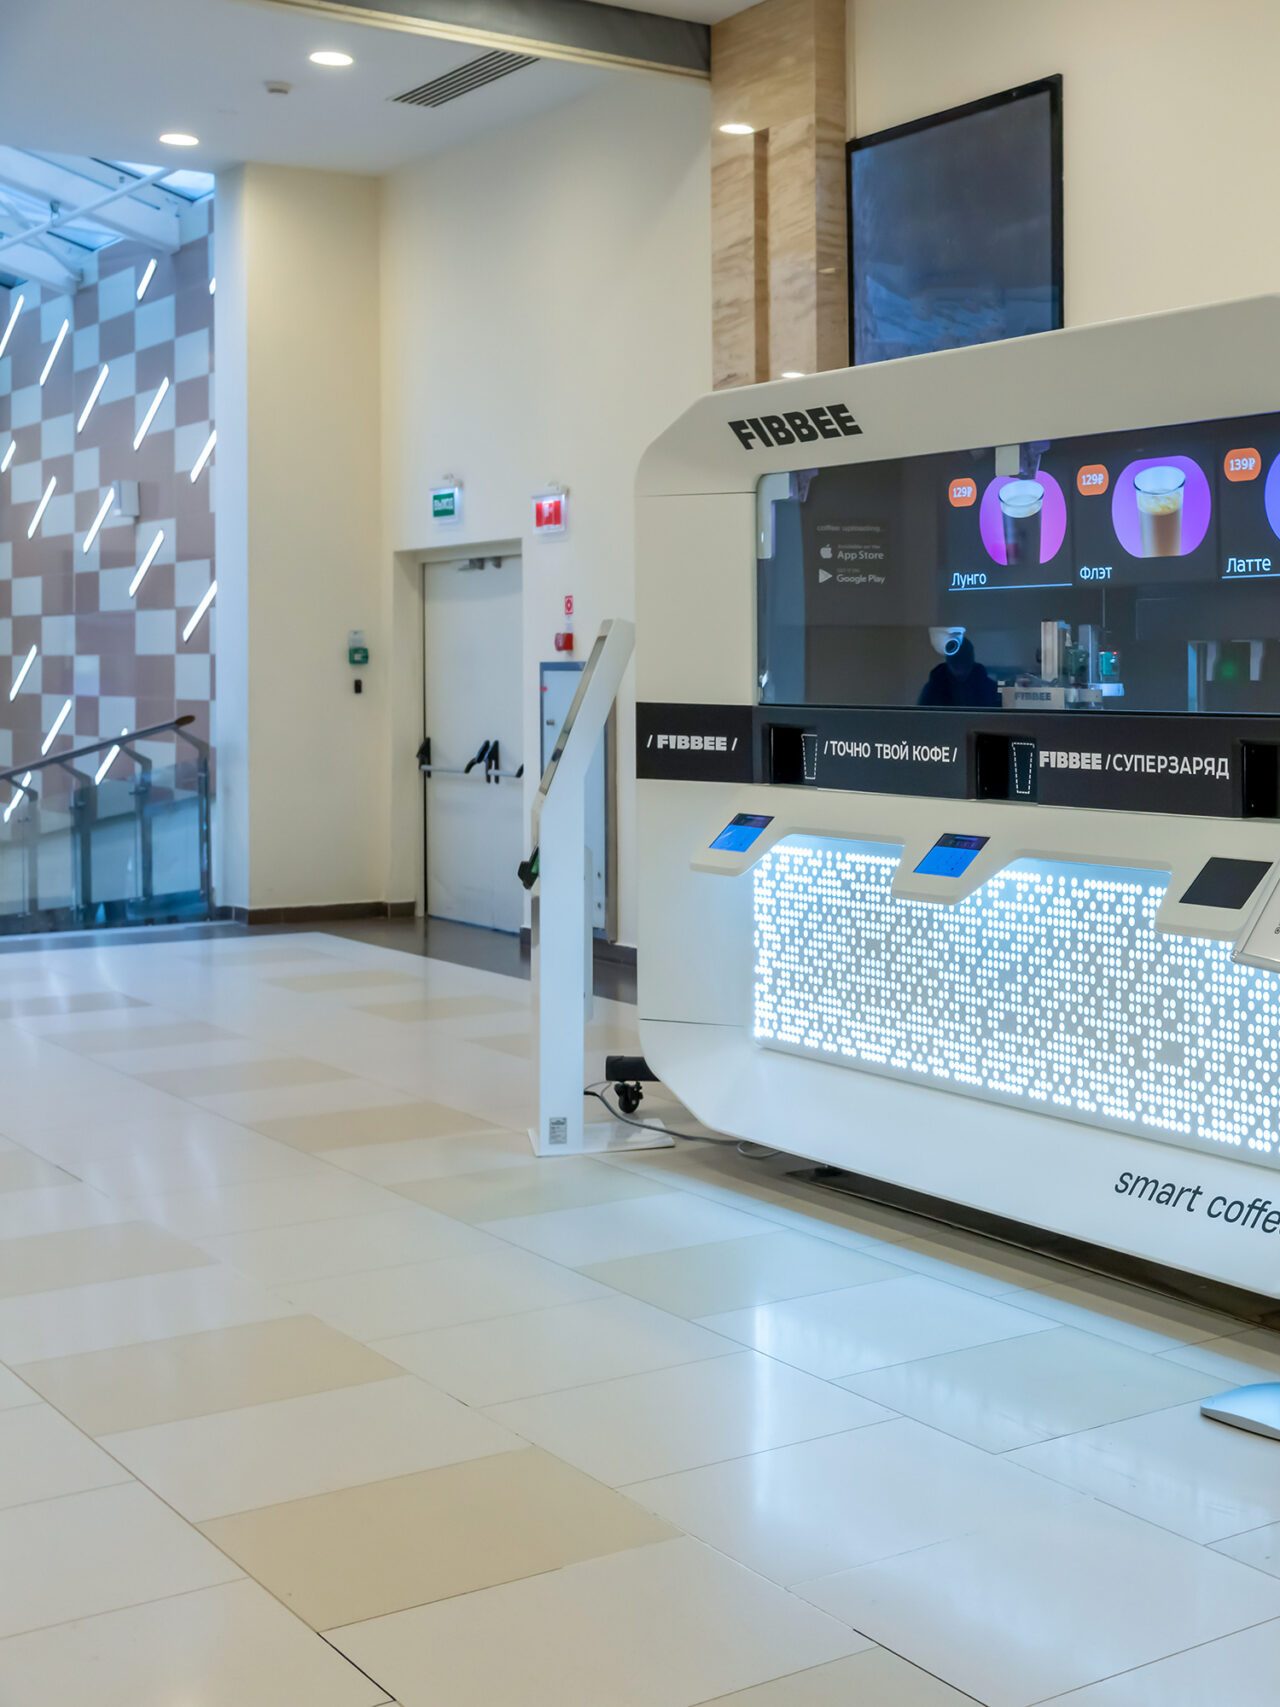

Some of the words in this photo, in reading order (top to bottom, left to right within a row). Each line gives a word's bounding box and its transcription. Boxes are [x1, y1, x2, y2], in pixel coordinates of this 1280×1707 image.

[728, 403, 863, 450] FIBBEE
[837, 551, 858, 561] App
[859, 550, 885, 560] Store
[1079, 566, 1113, 580] Флэт
[1226, 557, 1272, 573] Латте
[836, 574, 867, 584] Google
[868, 574, 886, 584] Play
[951, 572, 987, 588] Лунго
[656, 734, 728, 751] FIBBEE
[874, 741, 910, 761] ТВОЙ
[1039, 750, 1102, 770] FIBBEE
[1114, 1171, 1203, 1212] smart
